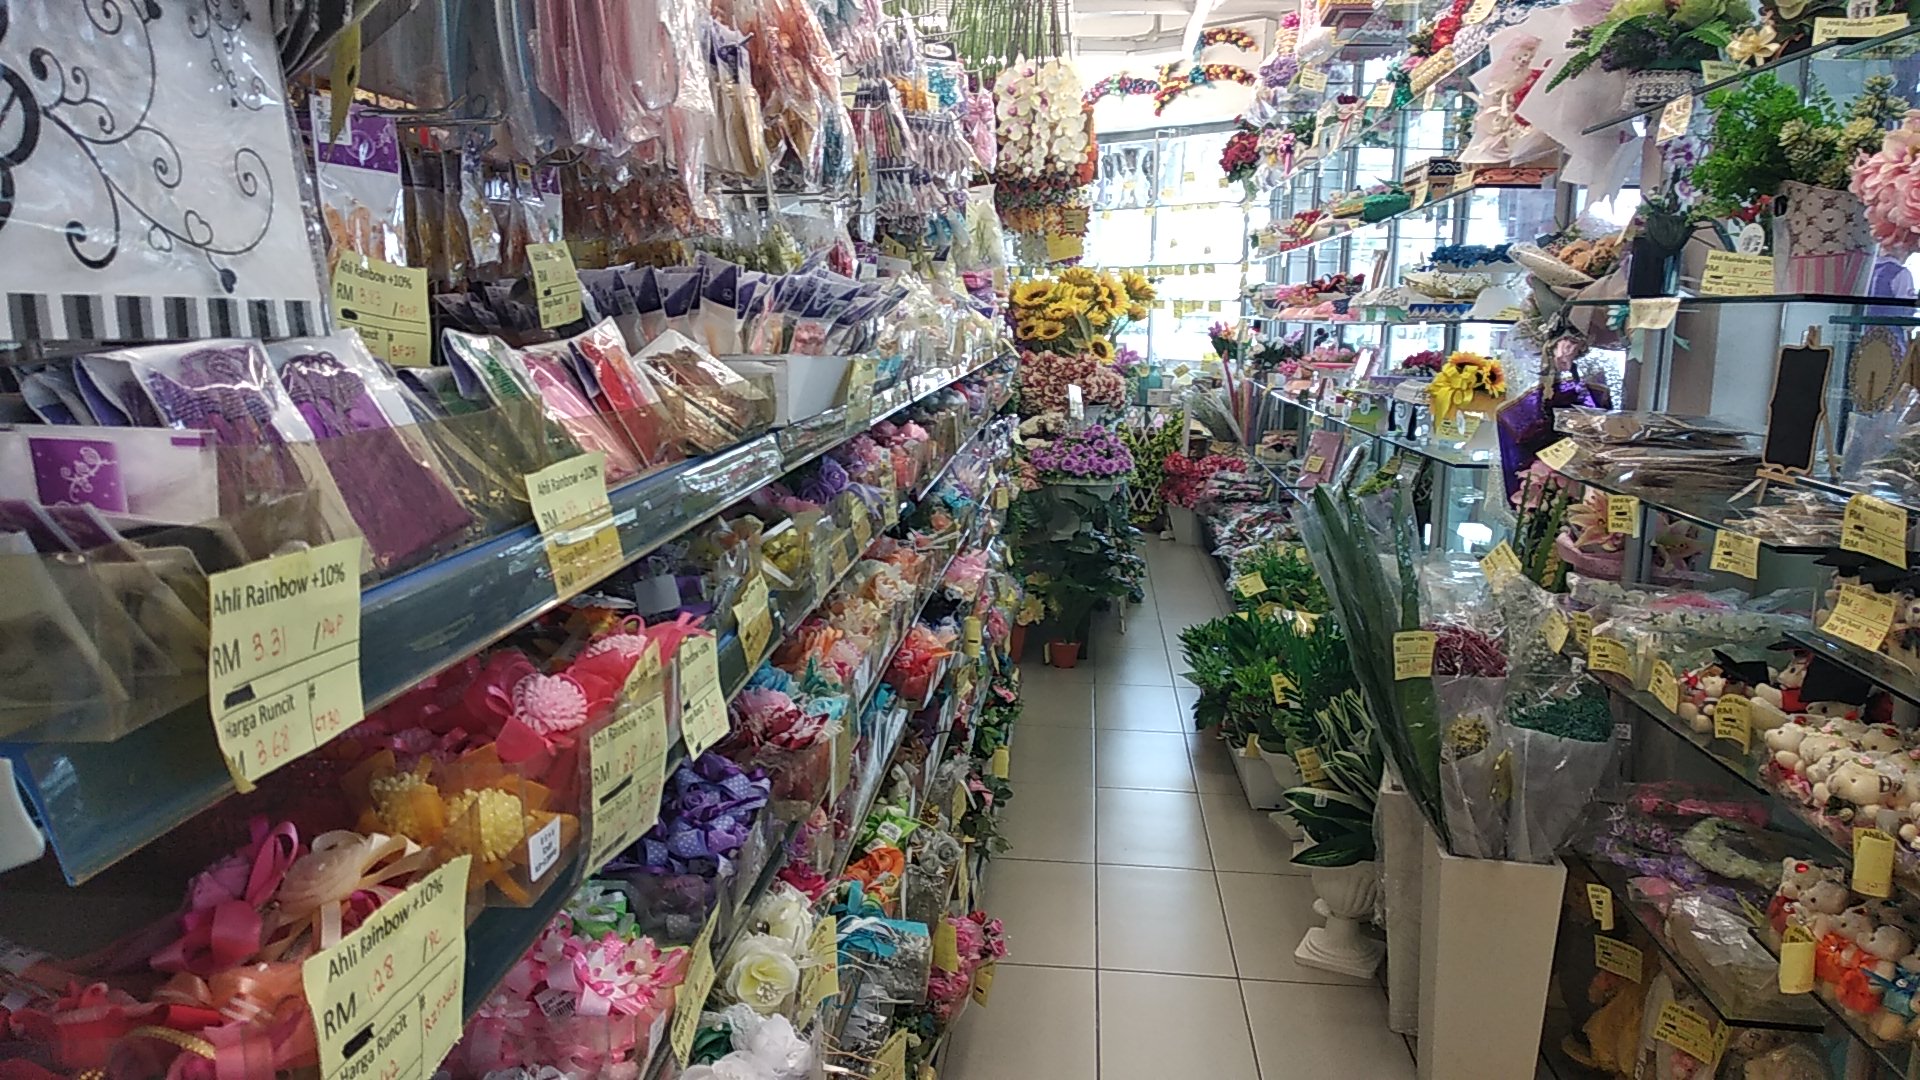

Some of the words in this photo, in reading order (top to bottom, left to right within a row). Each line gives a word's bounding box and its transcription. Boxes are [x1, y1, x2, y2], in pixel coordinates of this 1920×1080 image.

[336, 282, 354, 302] RM
[213, 588, 241, 616] Ahli
[246, 574, 309, 606] Rainbow
[310, 562, 346, 589] +10%
[212, 638, 241, 679] RM
[258, 694, 296, 725] Runcit
[328, 944, 358, 983] Ahli
[360, 903, 410, 959] Rainbow
[412, 874, 444, 910] +10%
[323, 992, 357, 1041] RM
[339, 1047, 375, 1080] Harga
[376, 1013, 408, 1056] Runcit
